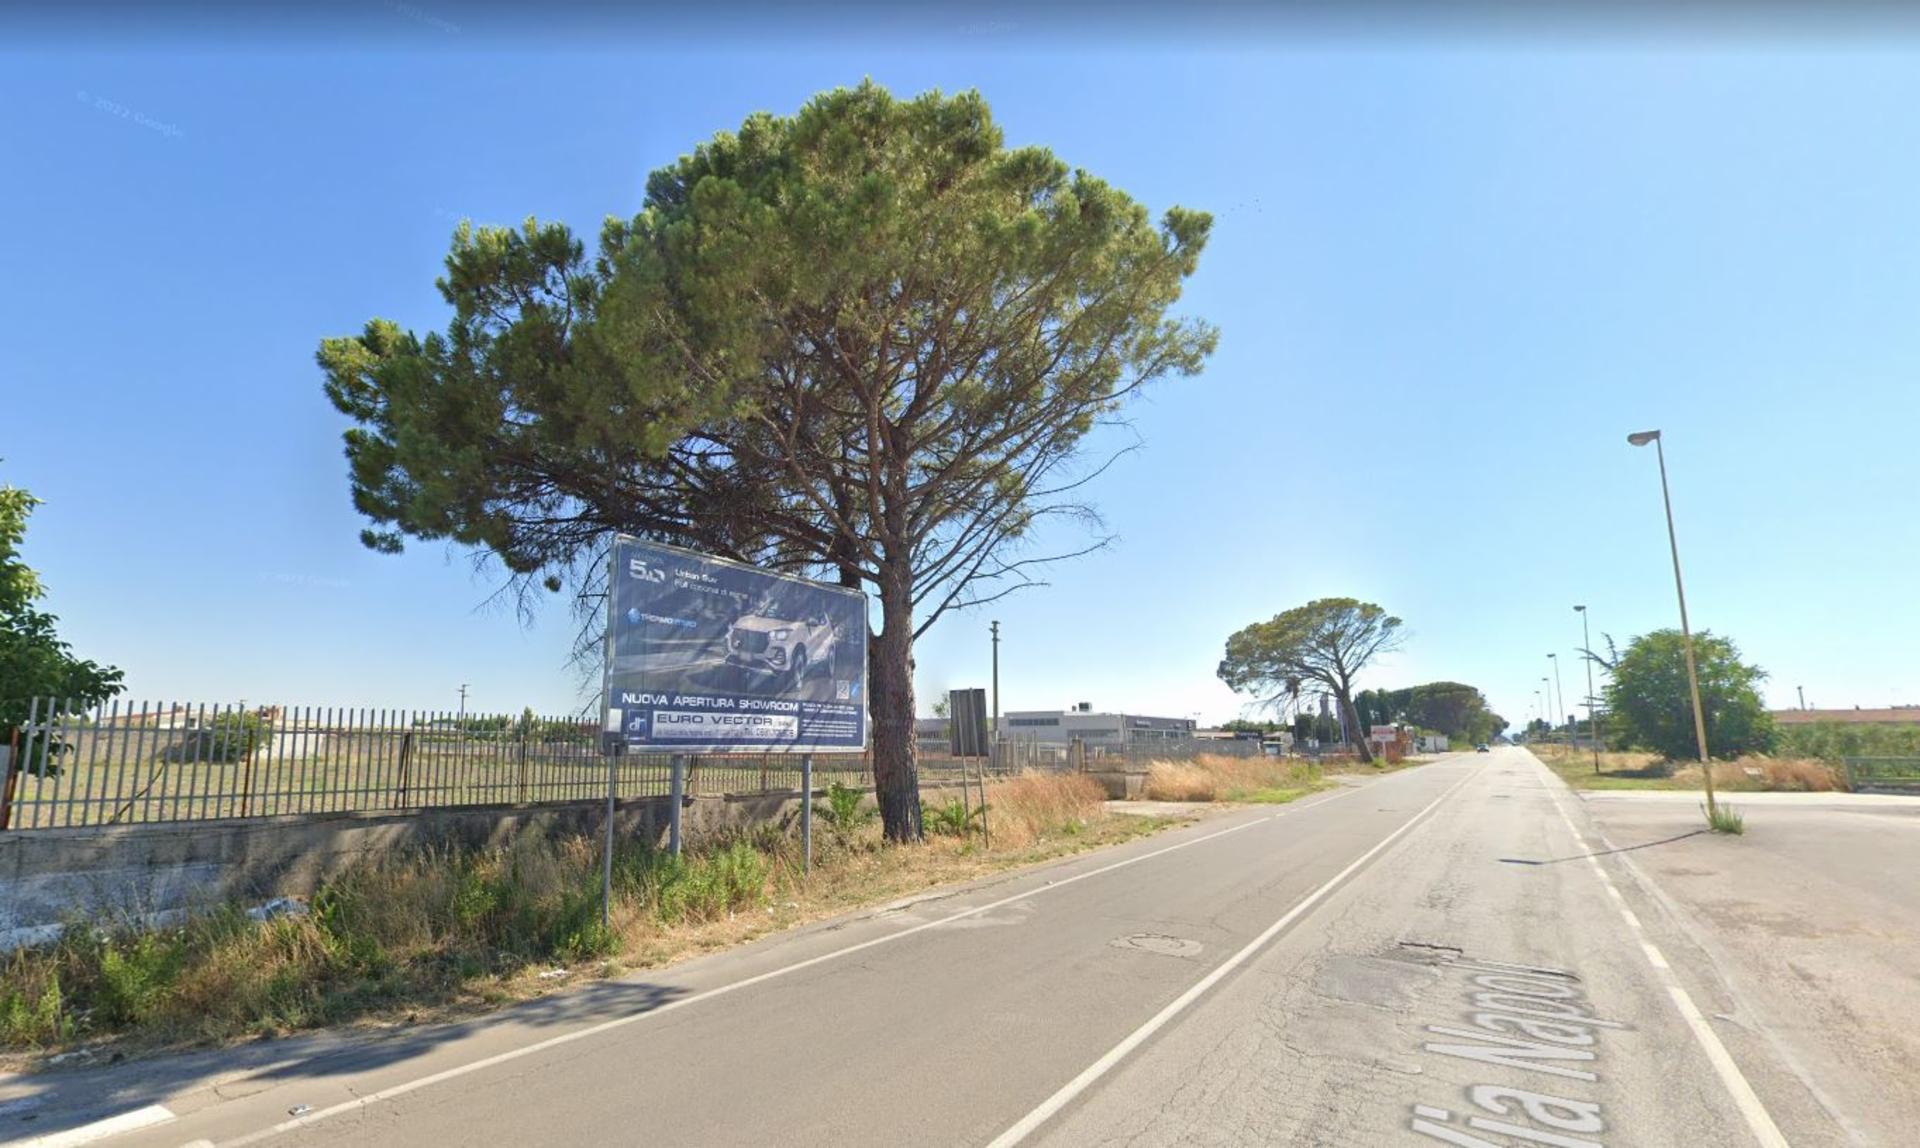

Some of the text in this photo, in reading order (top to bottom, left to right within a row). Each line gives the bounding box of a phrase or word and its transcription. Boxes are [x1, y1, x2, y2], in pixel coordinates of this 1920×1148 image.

[675, 568, 700, 581] Urban
[622, 692, 669, 705] NUOVA
[673, 695, 735, 709] APERTURA
[739, 699, 799, 712] SHOWROOM
[657, 713, 704, 724] EURO
[711, 715, 773, 726] VECTOR
